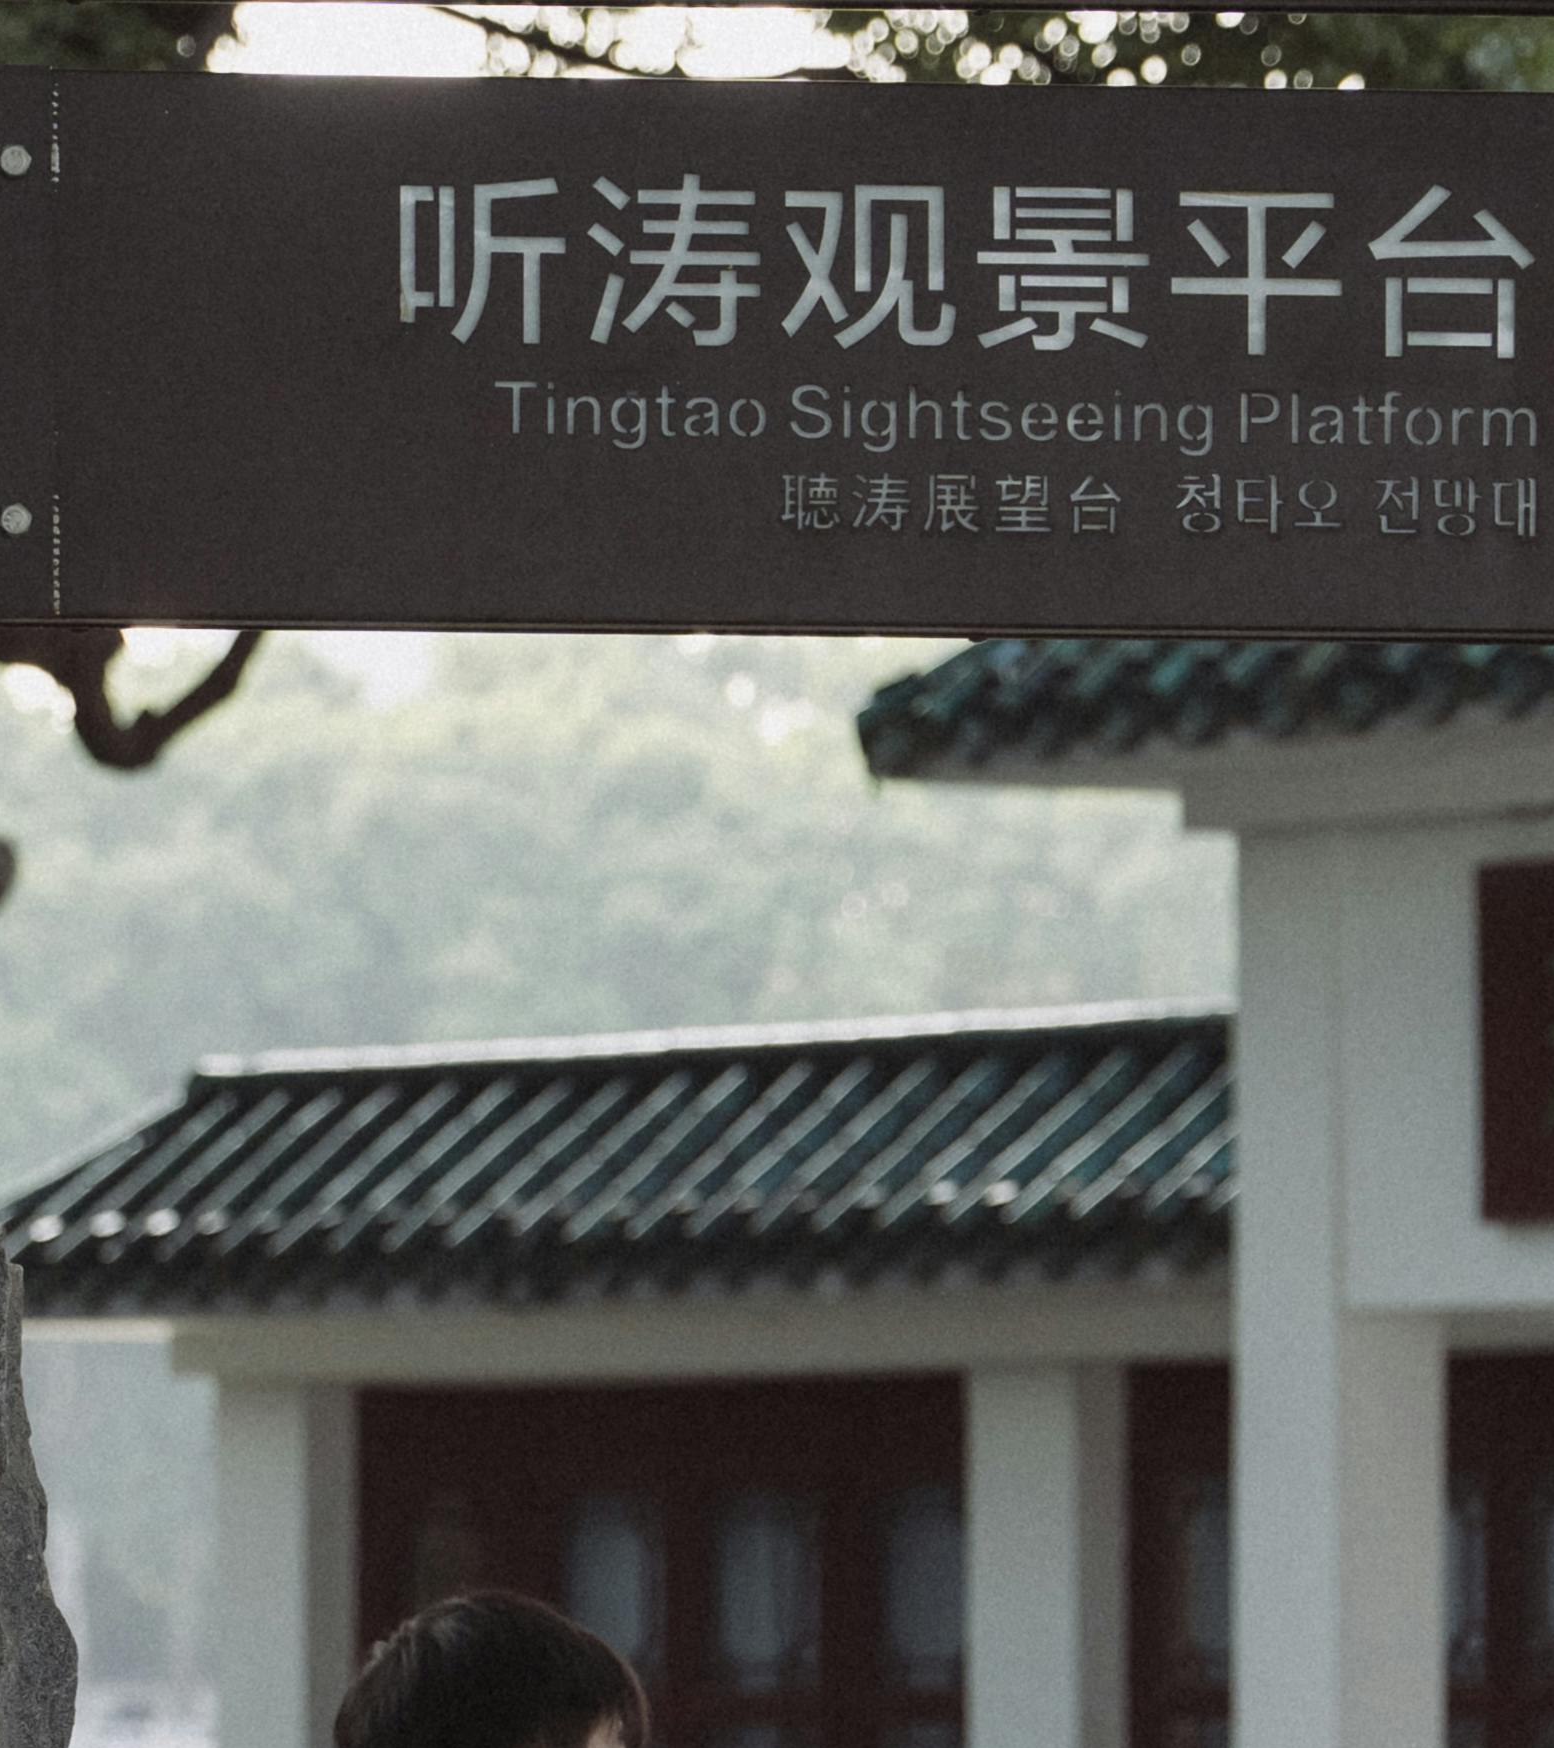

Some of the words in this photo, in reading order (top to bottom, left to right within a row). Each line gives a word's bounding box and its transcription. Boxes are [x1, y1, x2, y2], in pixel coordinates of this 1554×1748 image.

[395, 173, 1536, 360] 听涛观景平台
[494, 379, 768, 447] Tingtao
[789, 383, 1214, 457] Sightseeing
[1238, 390, 1538, 448] Platform
[1176, 473, 1341, 534] 청타오
[1375, 475, 1538, 538] 전망대
